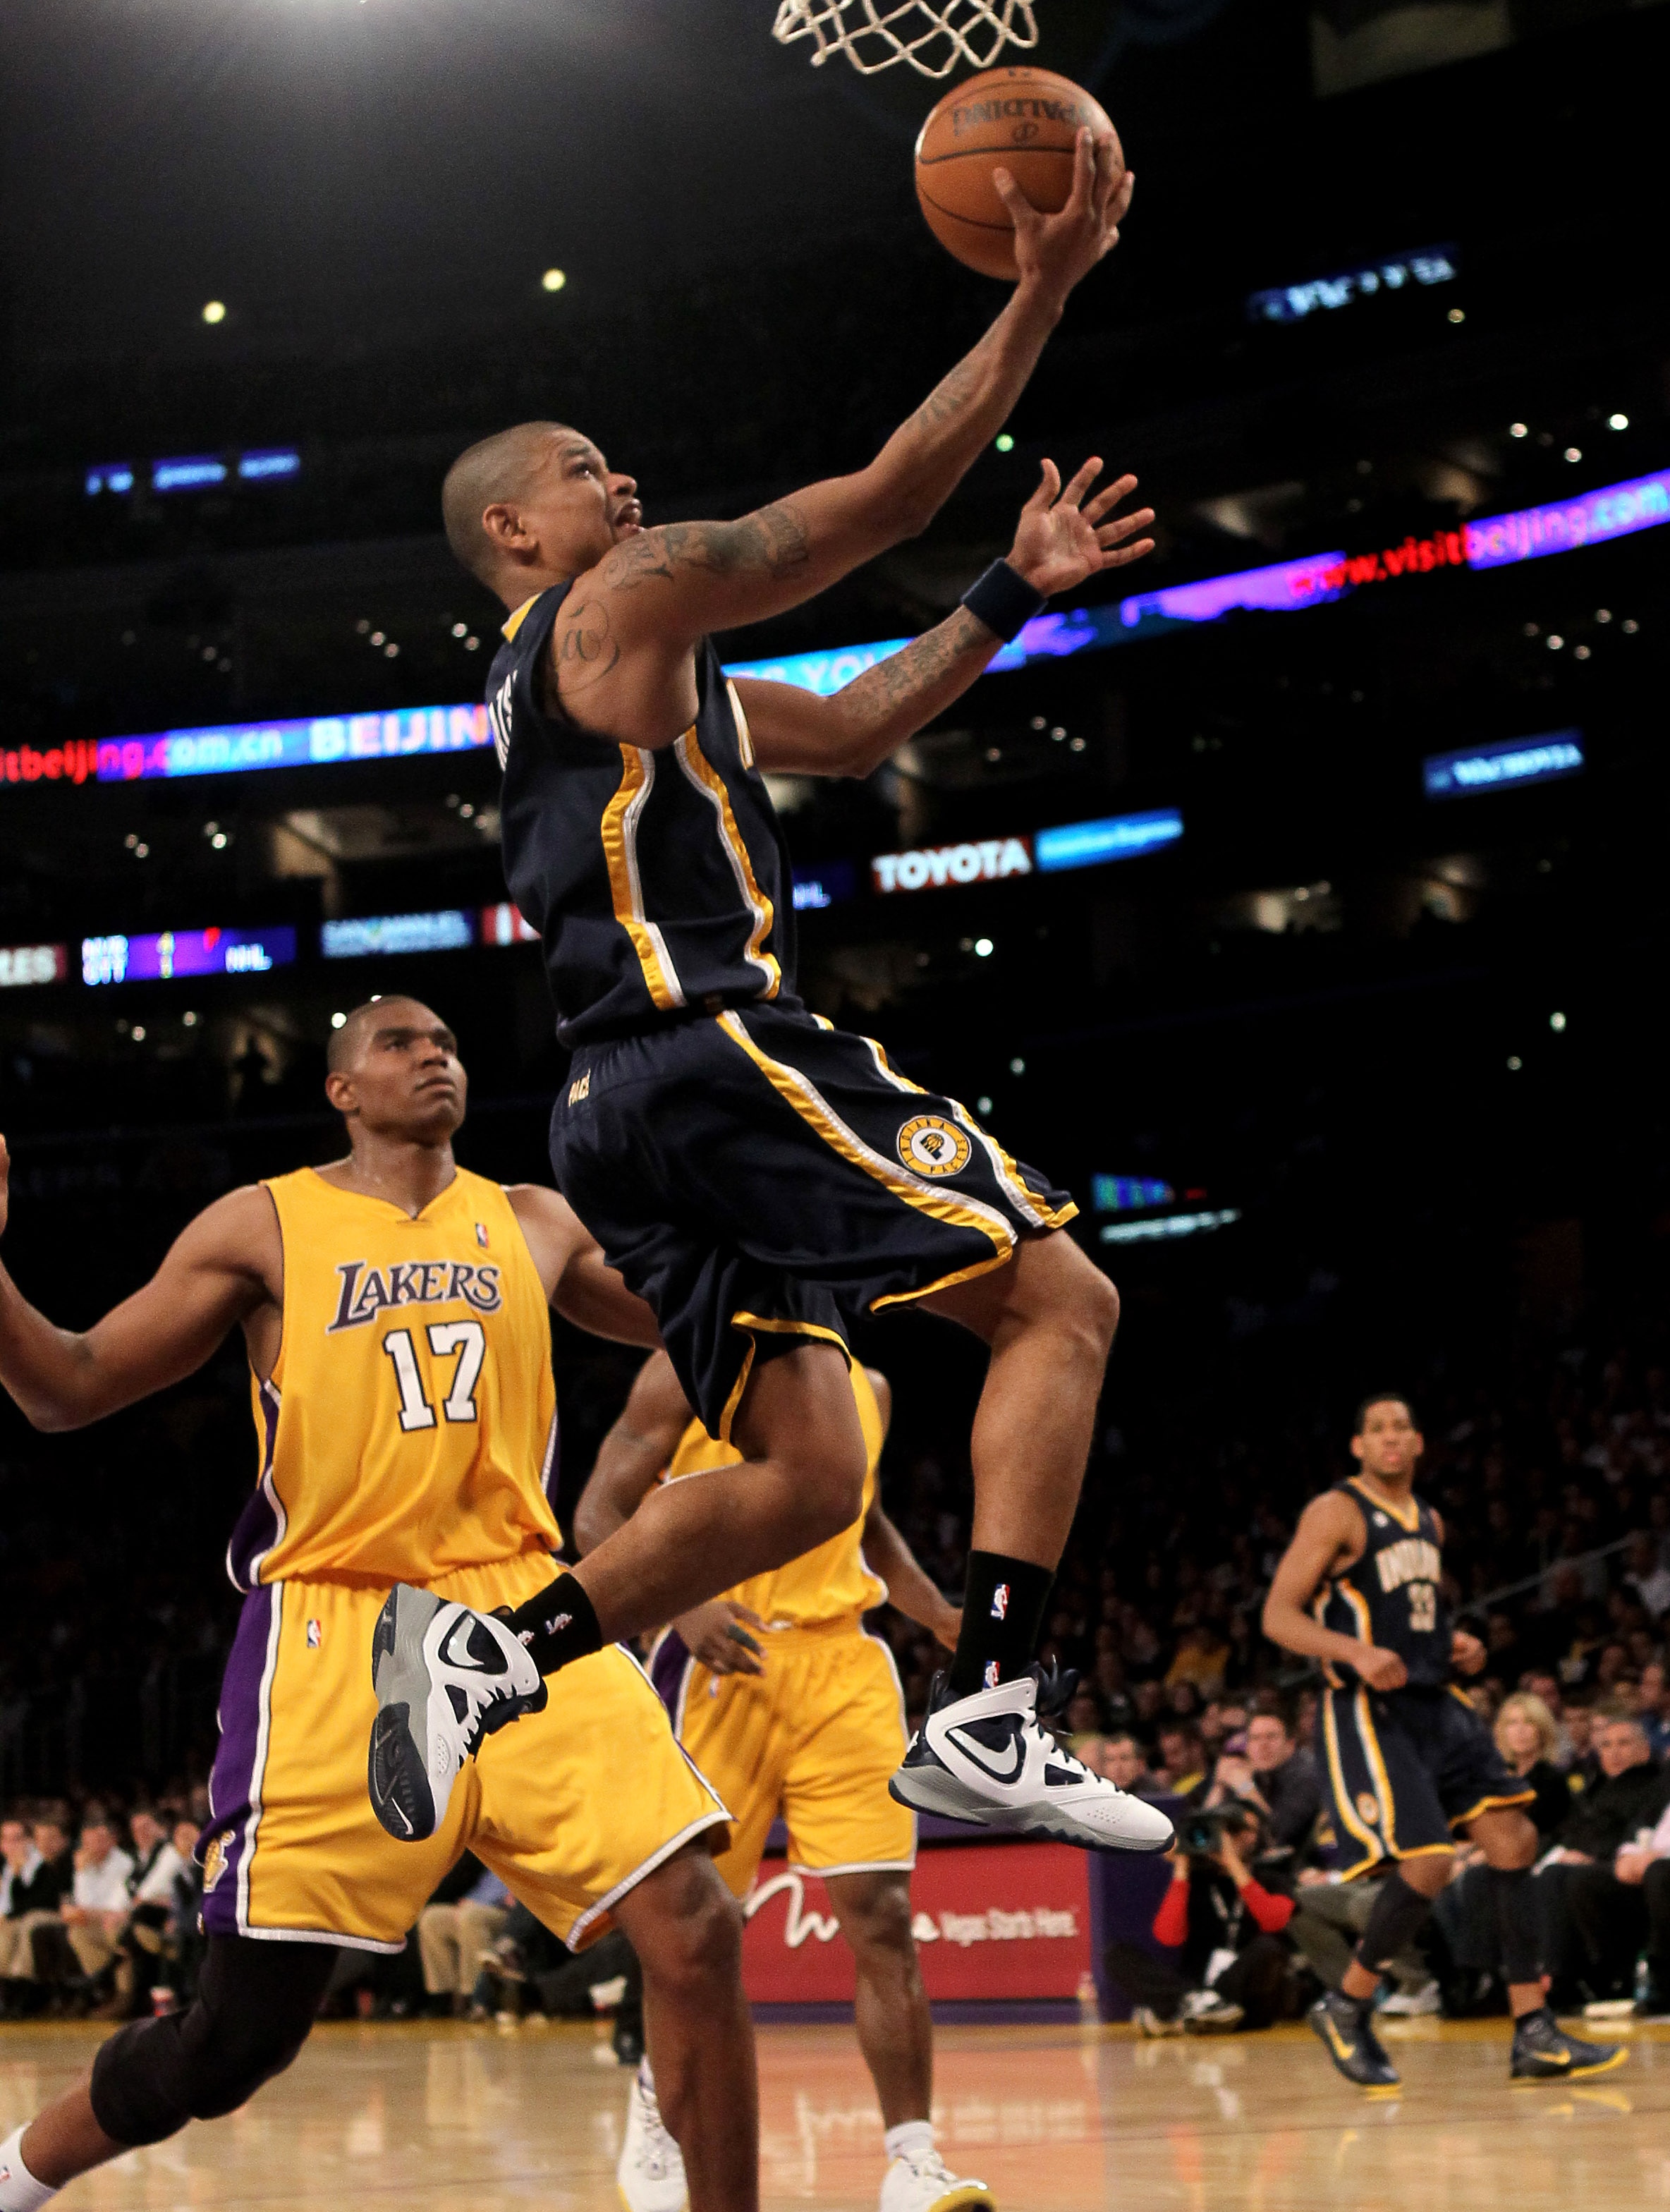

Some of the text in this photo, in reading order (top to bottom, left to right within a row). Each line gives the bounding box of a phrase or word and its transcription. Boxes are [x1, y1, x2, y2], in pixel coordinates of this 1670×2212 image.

[310, 705, 489, 763] BEIJIN
[872, 838, 1033, 893] TOYOTA
[901, 1118, 945, 1165] INDIANA
[326, 1260, 503, 1335] LAKERS
[383, 1320, 487, 1433] 17
